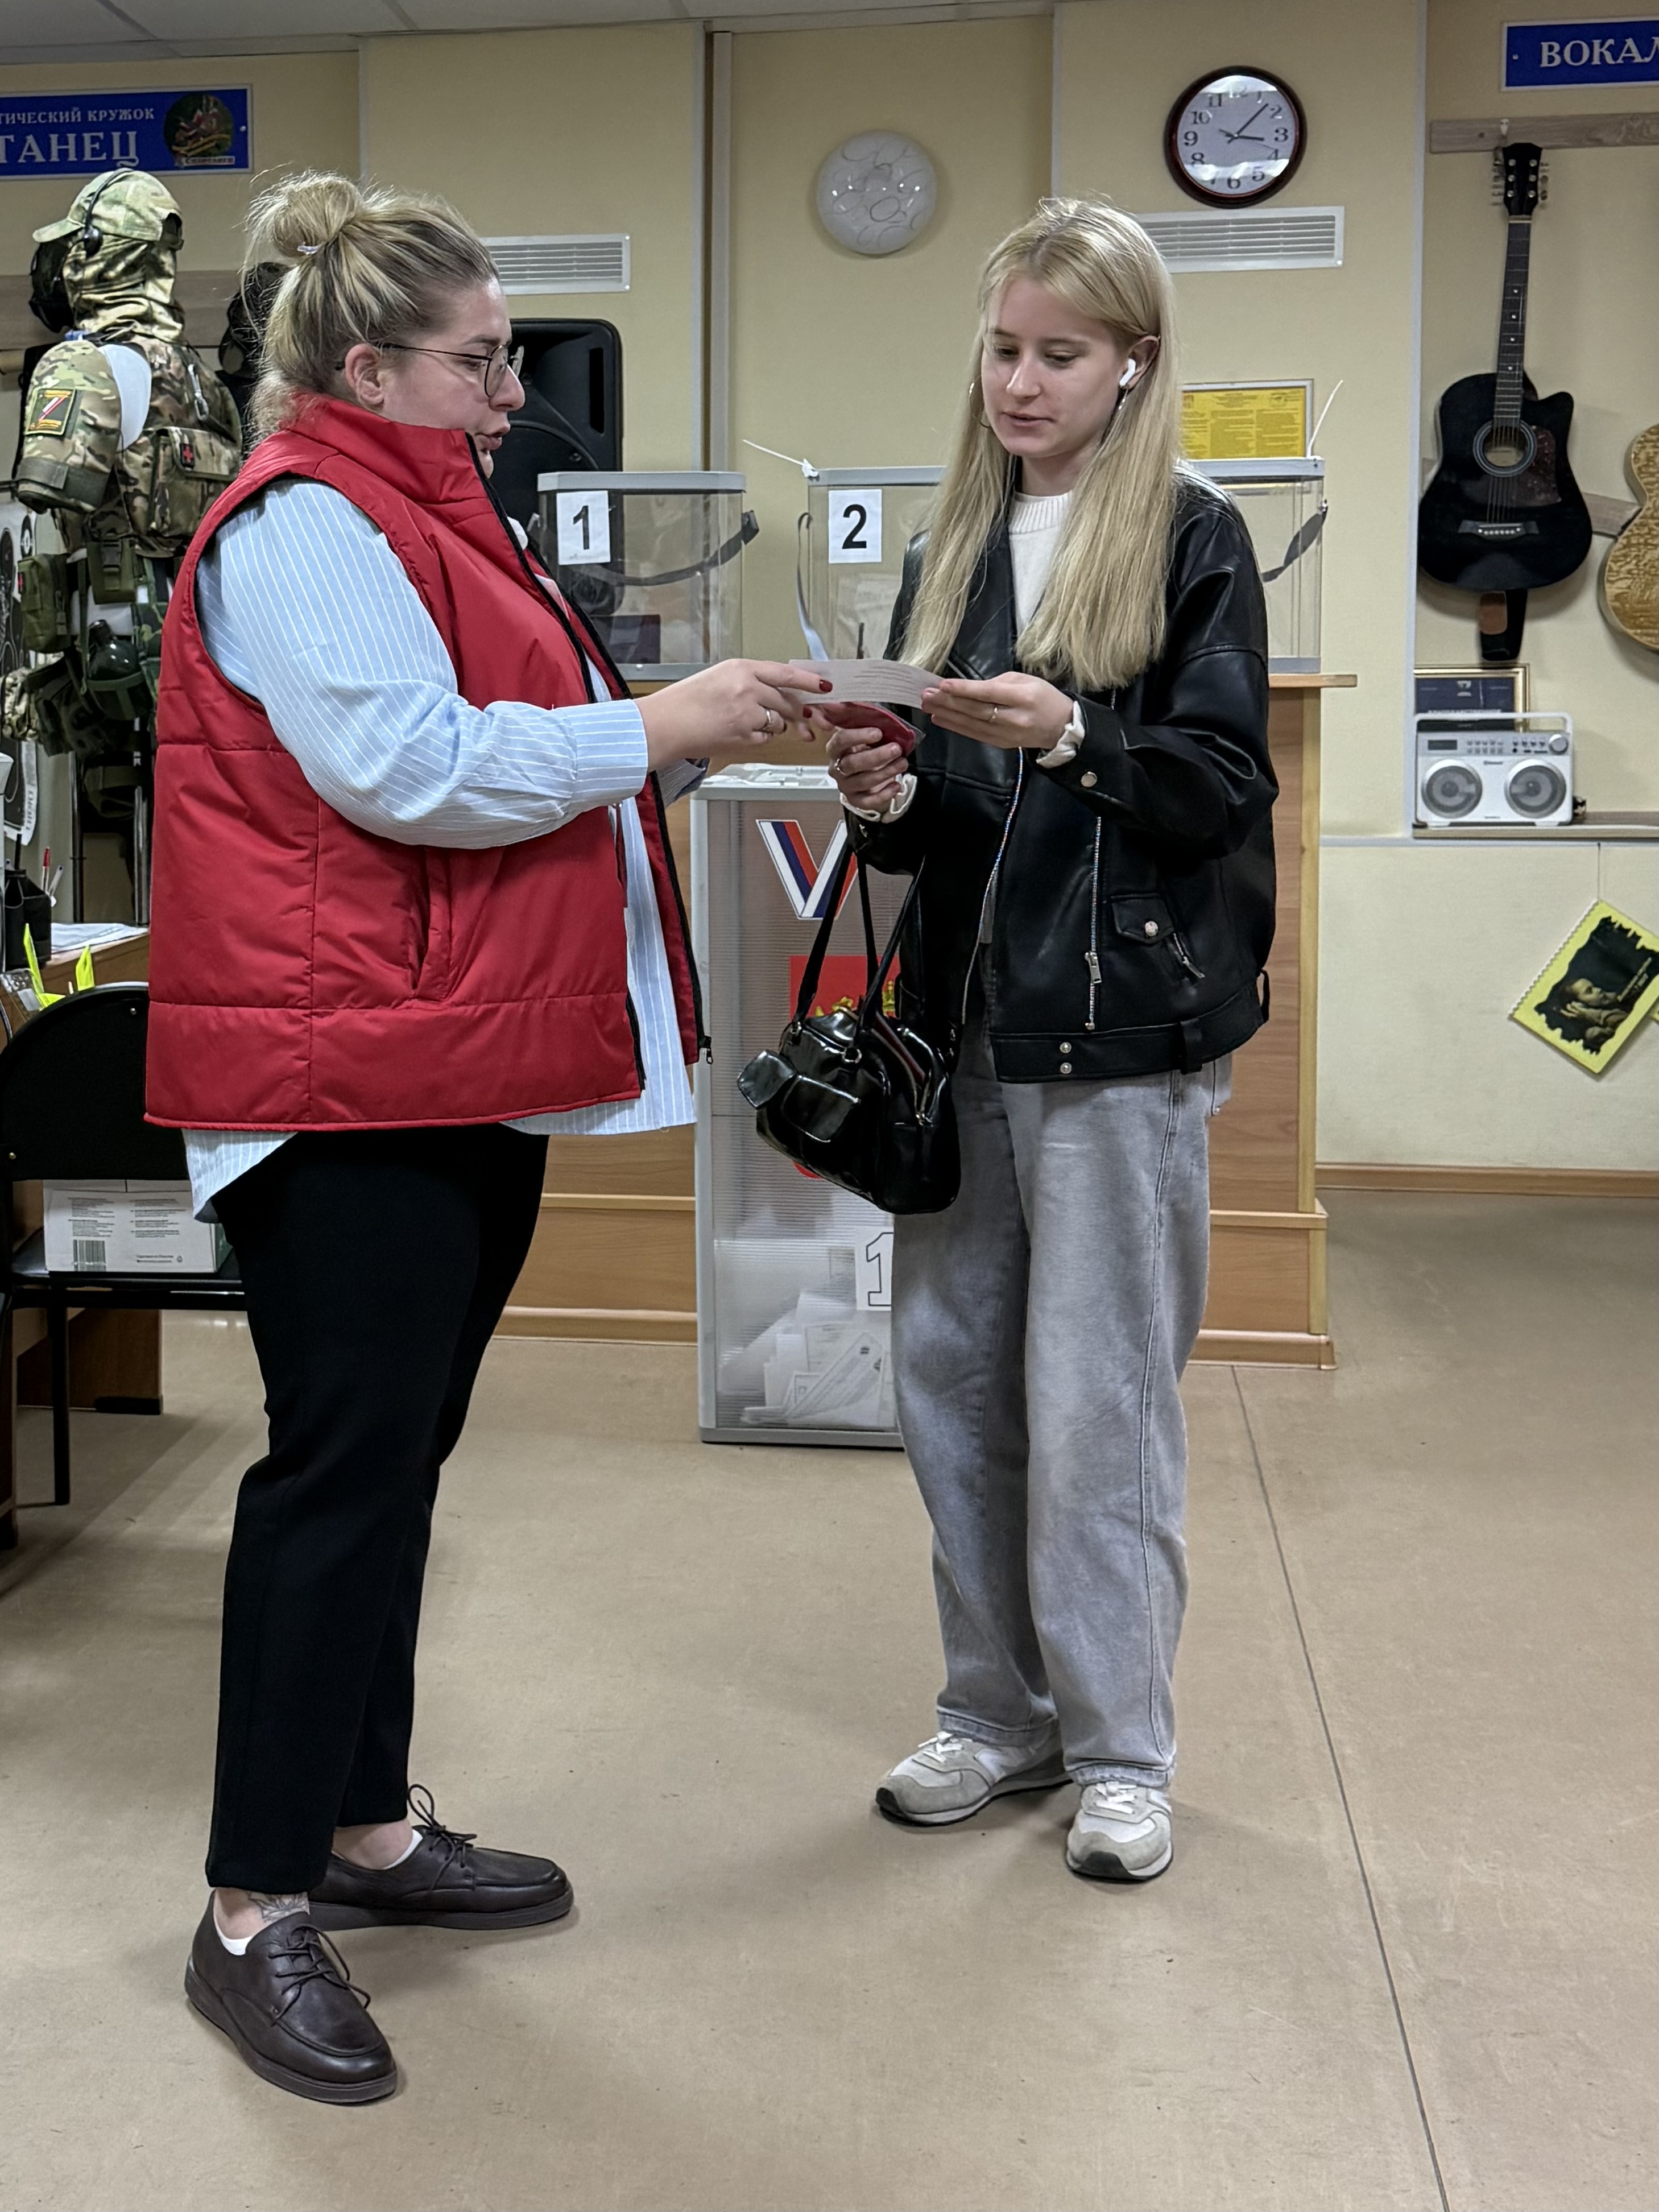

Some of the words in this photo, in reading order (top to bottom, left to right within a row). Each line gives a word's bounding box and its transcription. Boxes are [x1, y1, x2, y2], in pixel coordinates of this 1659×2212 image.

[88, 108, 155, 122] КРУЖОК
[1191, 110, 1213, 125] 10
[1270, 104, 1282, 119] 2
[1184, 131, 1198, 146] 9
[1274, 127, 1289, 142] 3
[0, 130, 139, 167] ТАНЕЦ
[1191, 152, 1205, 167] 8
[1252, 166, 1265, 182] 5
[1227, 175, 1241, 189] 6
[573, 505, 590, 551] 1
[842, 504, 867, 549] 2
[866, 1231, 893, 1306] 1
